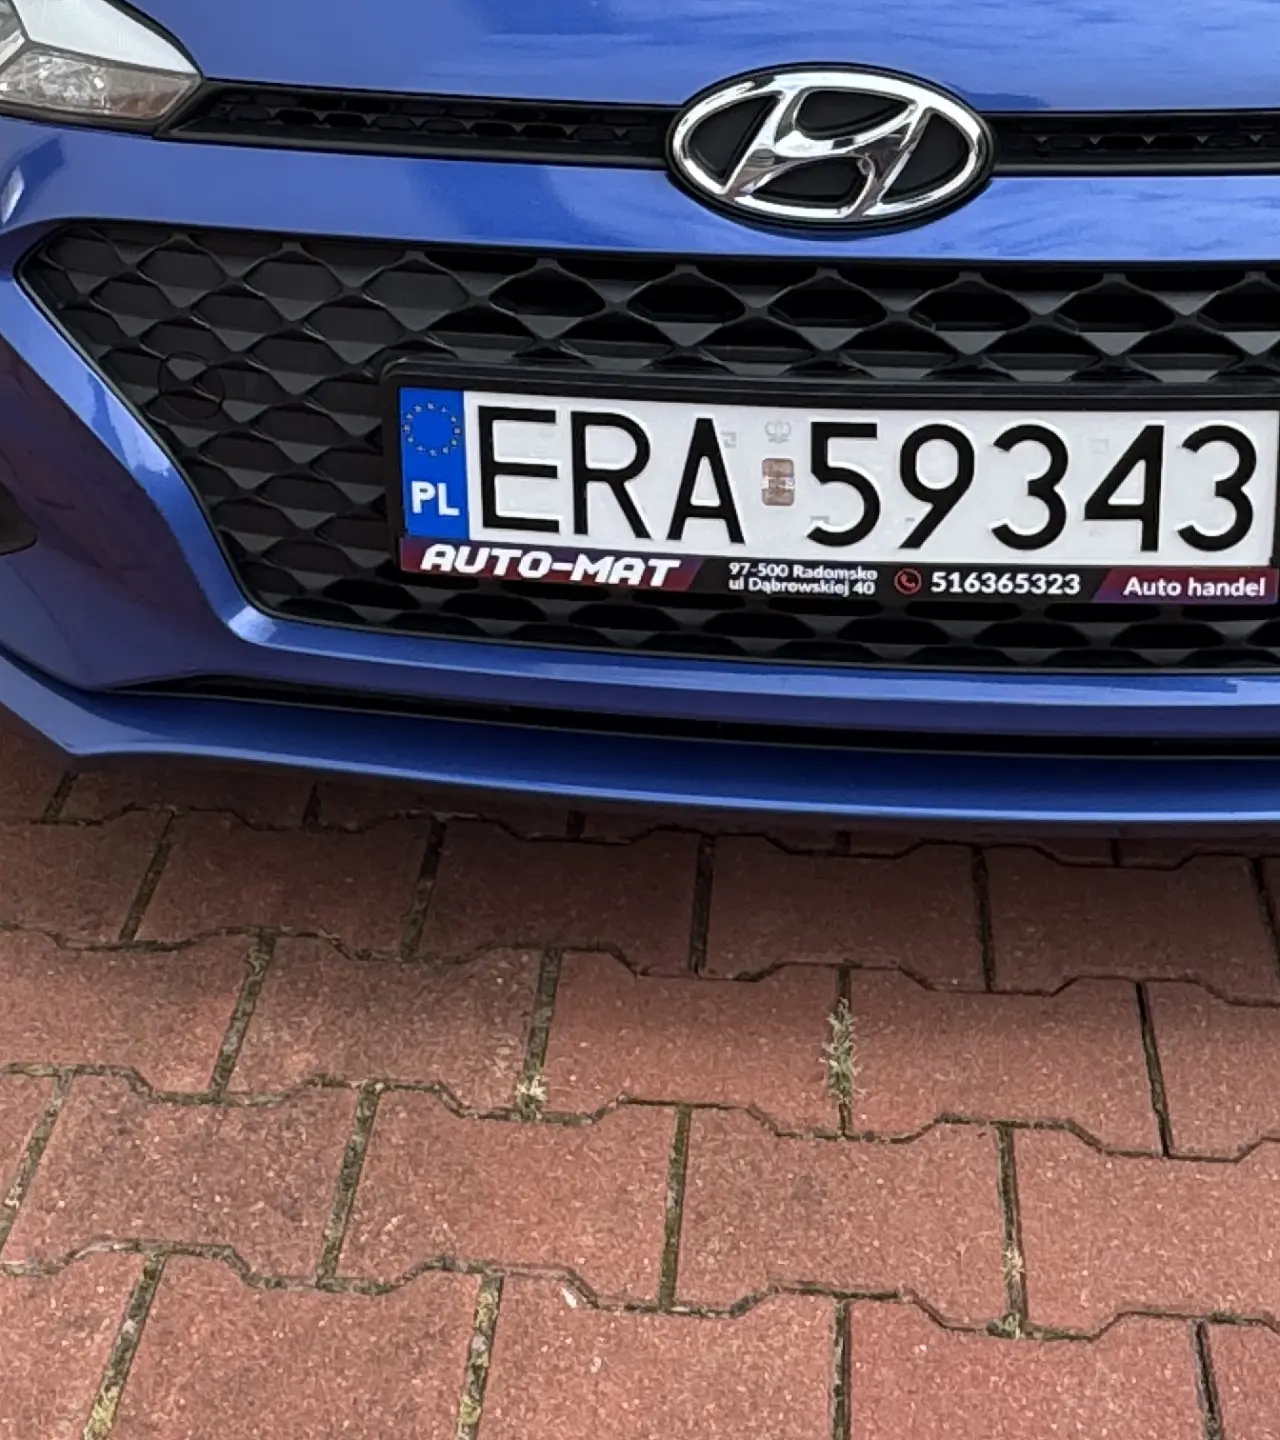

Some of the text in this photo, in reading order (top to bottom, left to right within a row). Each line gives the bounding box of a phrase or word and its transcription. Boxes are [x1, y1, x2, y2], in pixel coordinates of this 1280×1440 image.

[478, 405, 1258, 552] ERA 59343
[411, 480, 460, 516] PL
[421, 544, 681, 587] AUTO-MAT
[728, 562, 878, 581] 97-500 Radomsko
[728, 576, 876, 597] ul Dąbrowskiej 40
[931, 571, 1081, 595] 516365323
[1123, 576, 1266, 597] Auto handel
